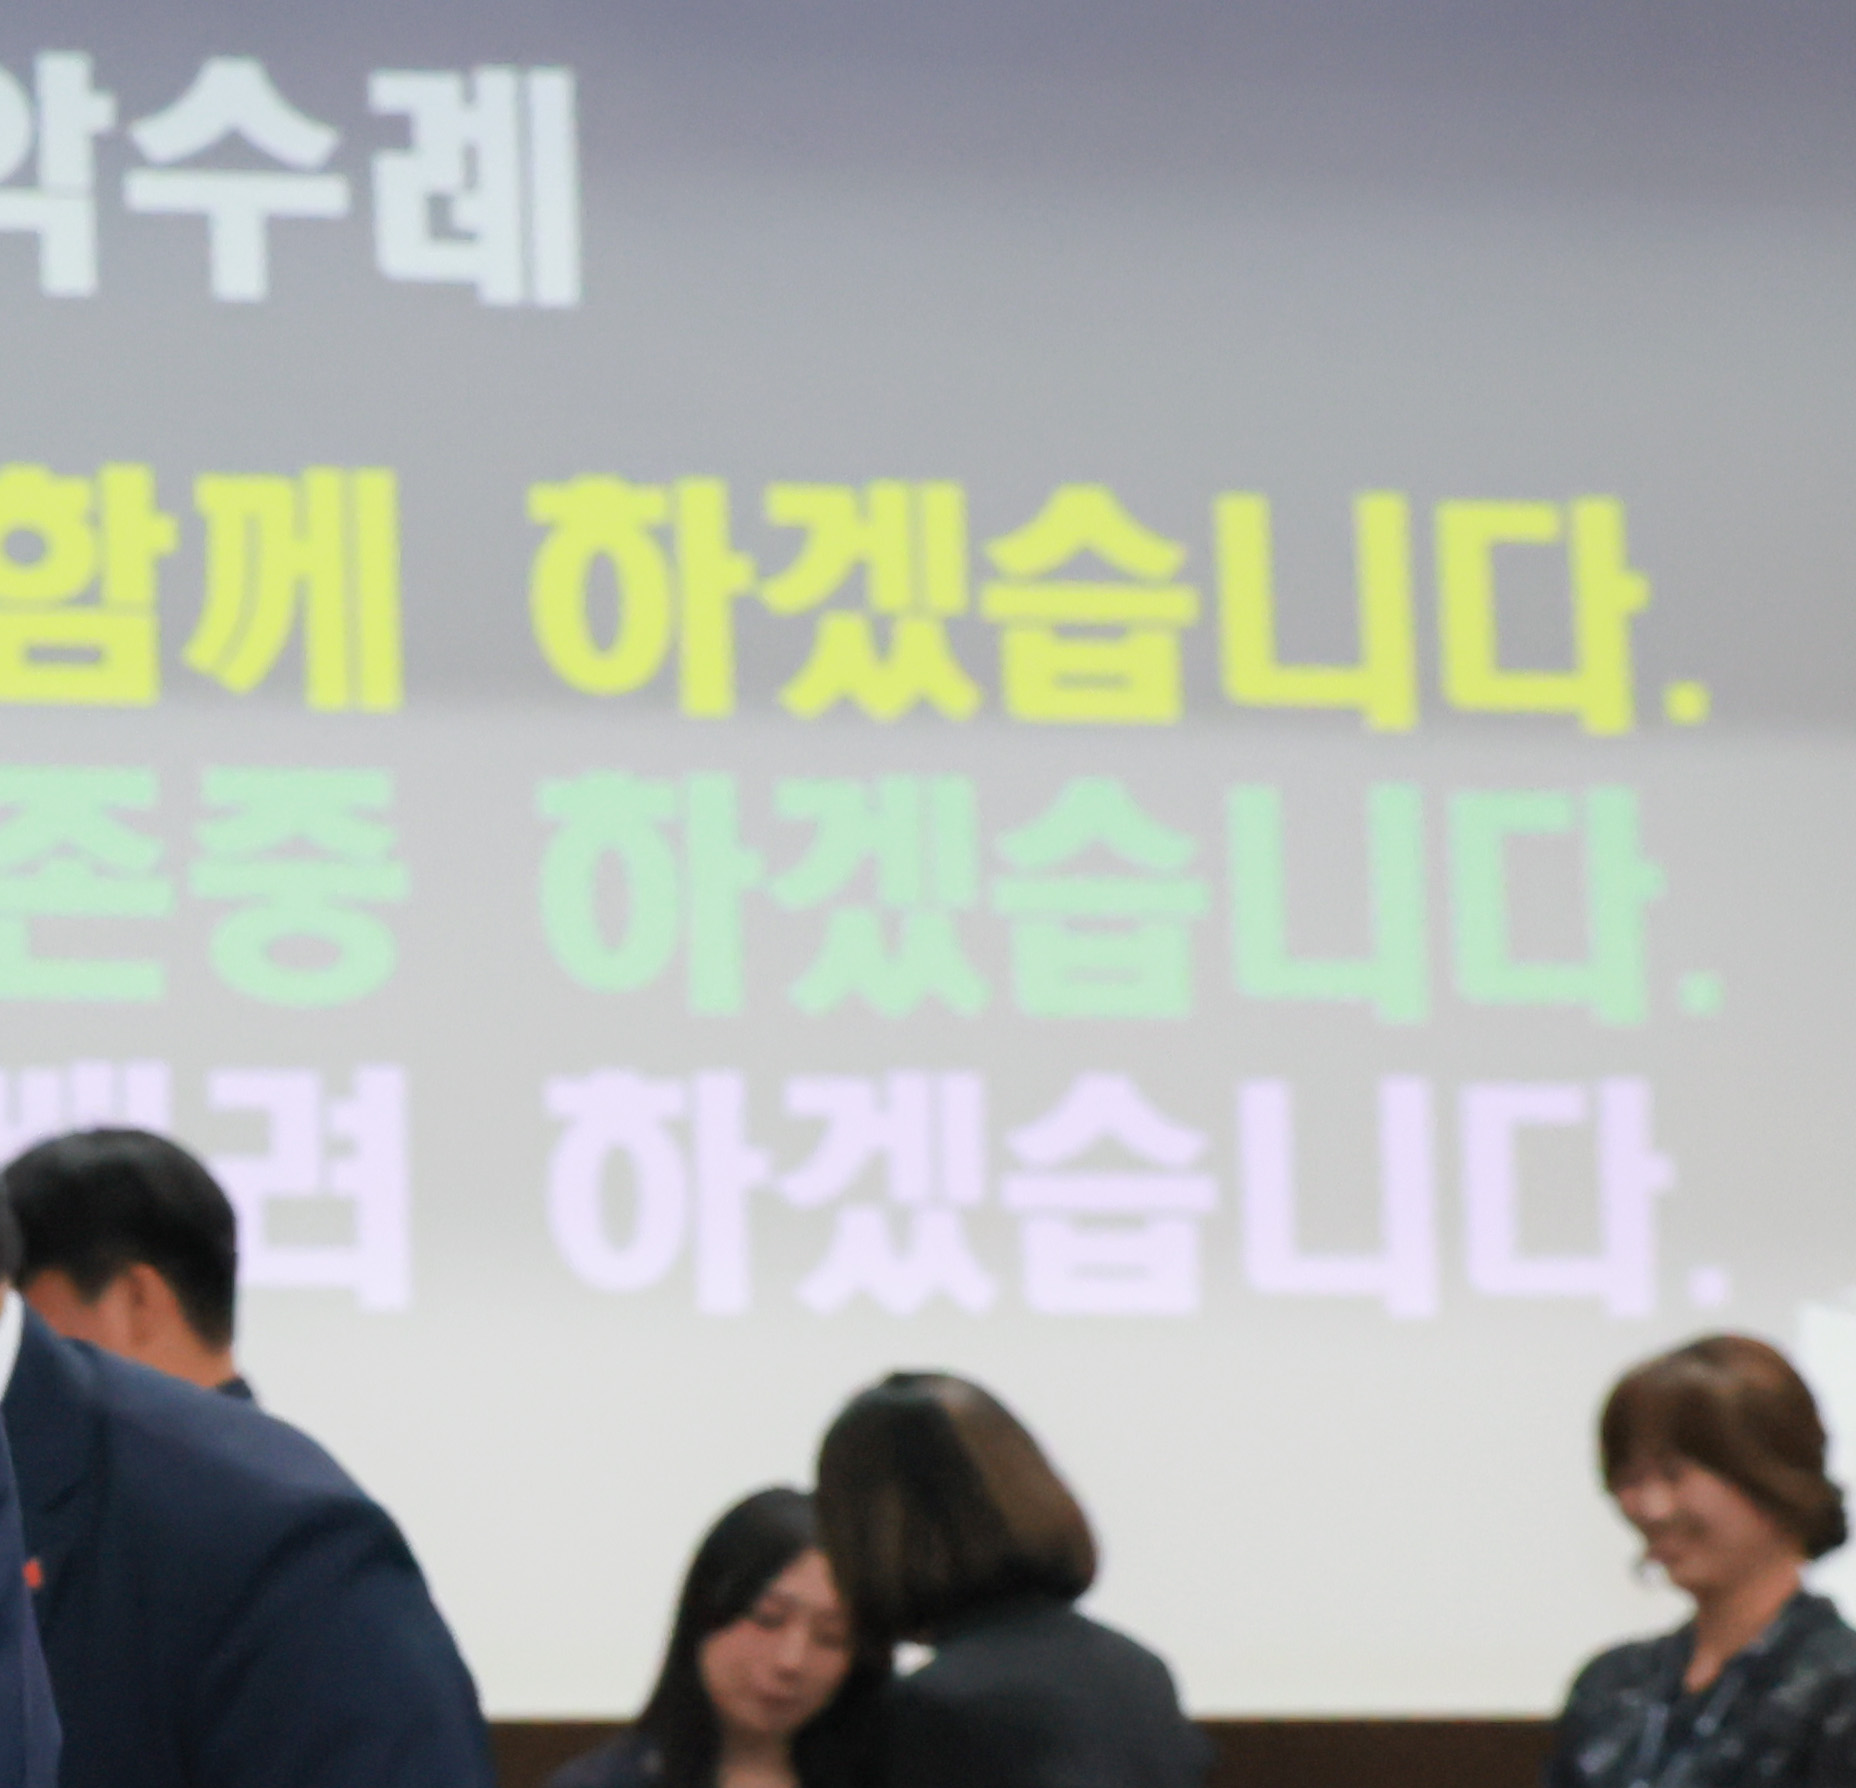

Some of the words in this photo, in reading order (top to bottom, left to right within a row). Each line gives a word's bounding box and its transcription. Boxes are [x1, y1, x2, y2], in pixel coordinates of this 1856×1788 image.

[525, 472, 1712, 738] 하겠습니다.
[533, 767, 1725, 1028] 하겠습니다.
[541, 1066, 1729, 1319] 하겠습니다.
